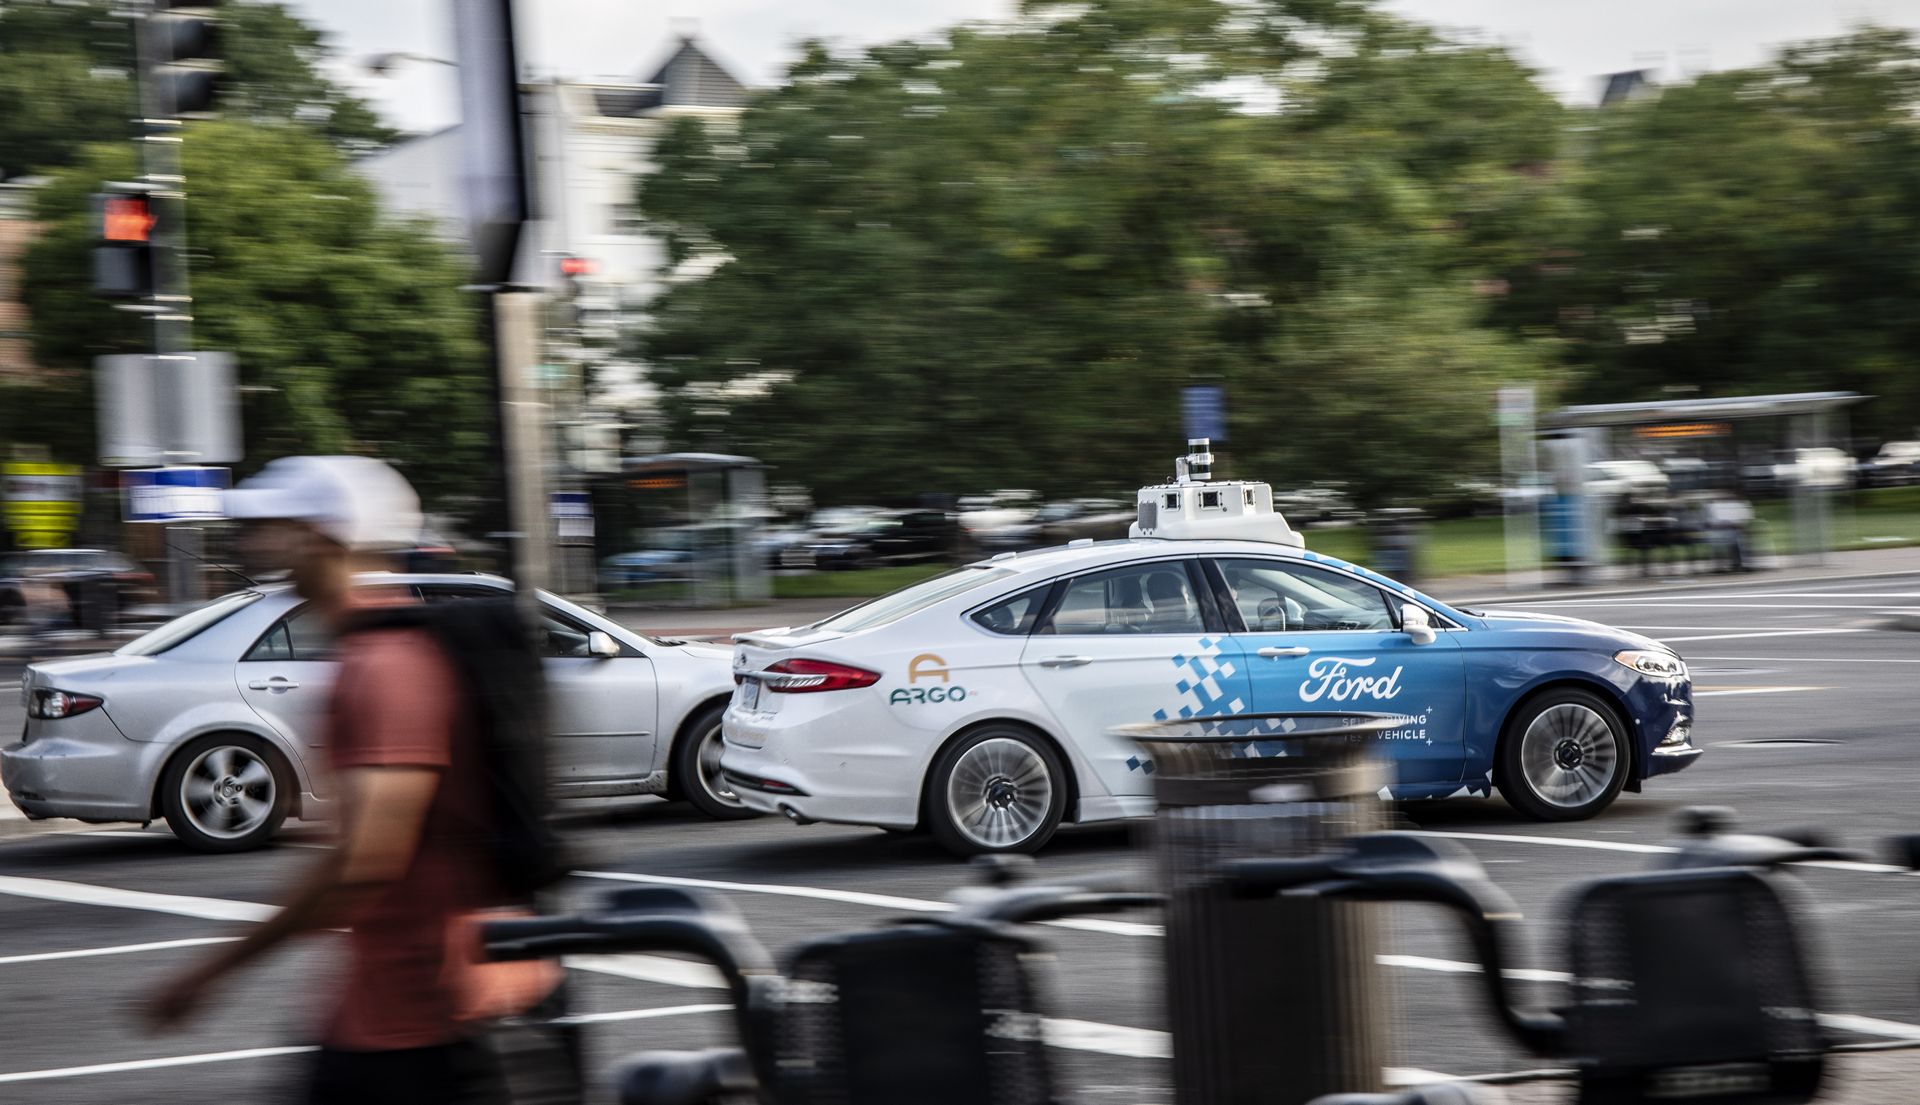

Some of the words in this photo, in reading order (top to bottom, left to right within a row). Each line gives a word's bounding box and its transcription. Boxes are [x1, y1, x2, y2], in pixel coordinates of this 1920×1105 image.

[1299, 656, 1403, 702] Ford
[890, 686, 966, 705] ARGO
[1377, 729, 1426, 740] VEHICLE
